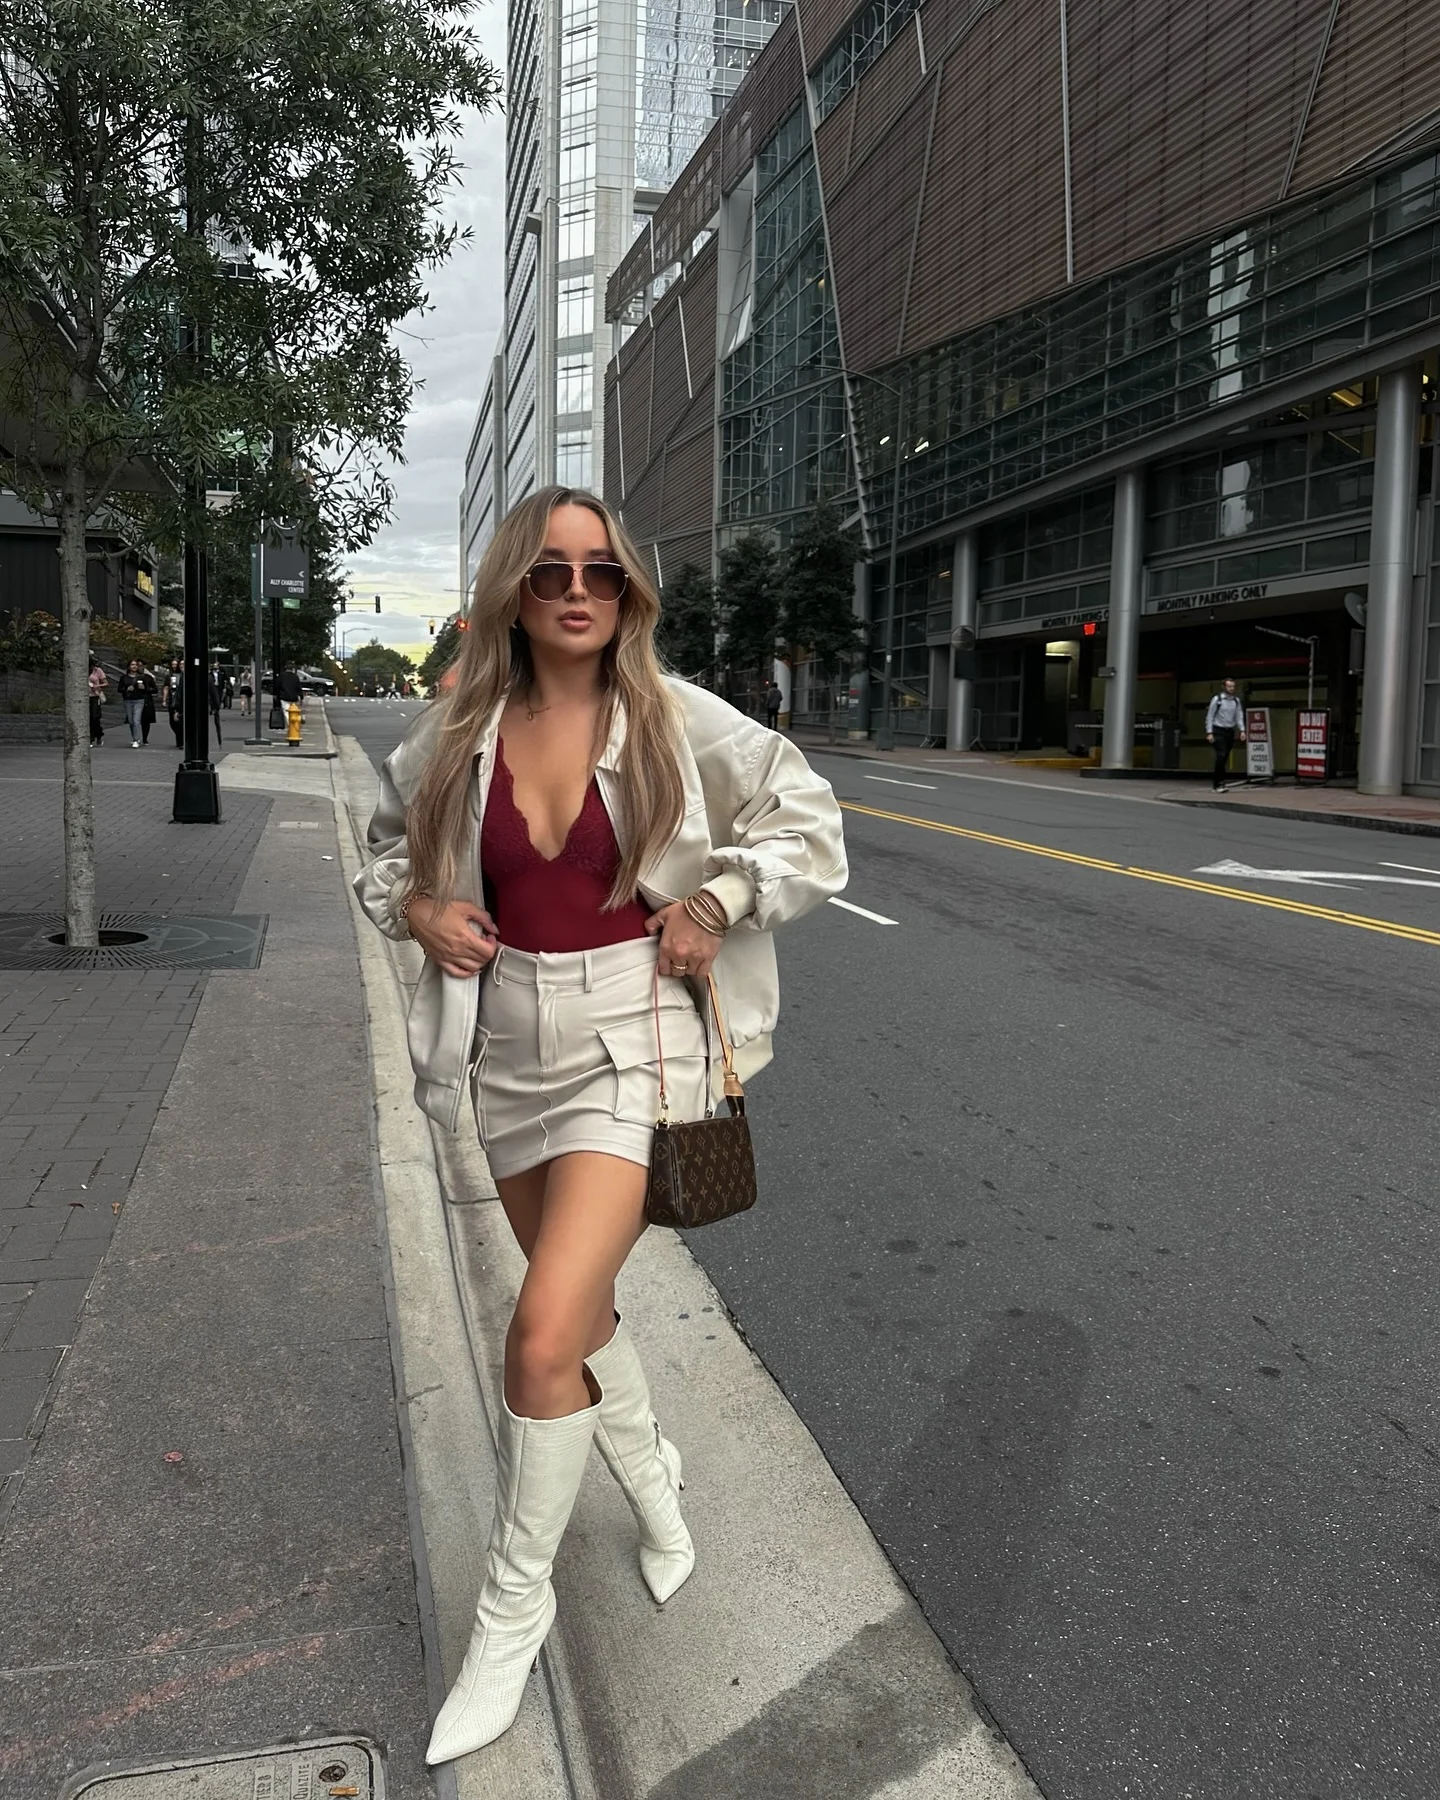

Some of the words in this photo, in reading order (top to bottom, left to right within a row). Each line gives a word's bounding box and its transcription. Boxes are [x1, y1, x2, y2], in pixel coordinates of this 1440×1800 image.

[281, 579, 304, 587] CHARLOTTE
[1157, 596, 1197, 612] MONTHLY
[1200, 589, 1239, 606] PARKING
[1241, 584, 1268, 599] ONLY
[1300, 712, 1310, 727] DO
[1311, 712, 1327, 727] NOT
[1302, 728, 1323, 743] ENTER
